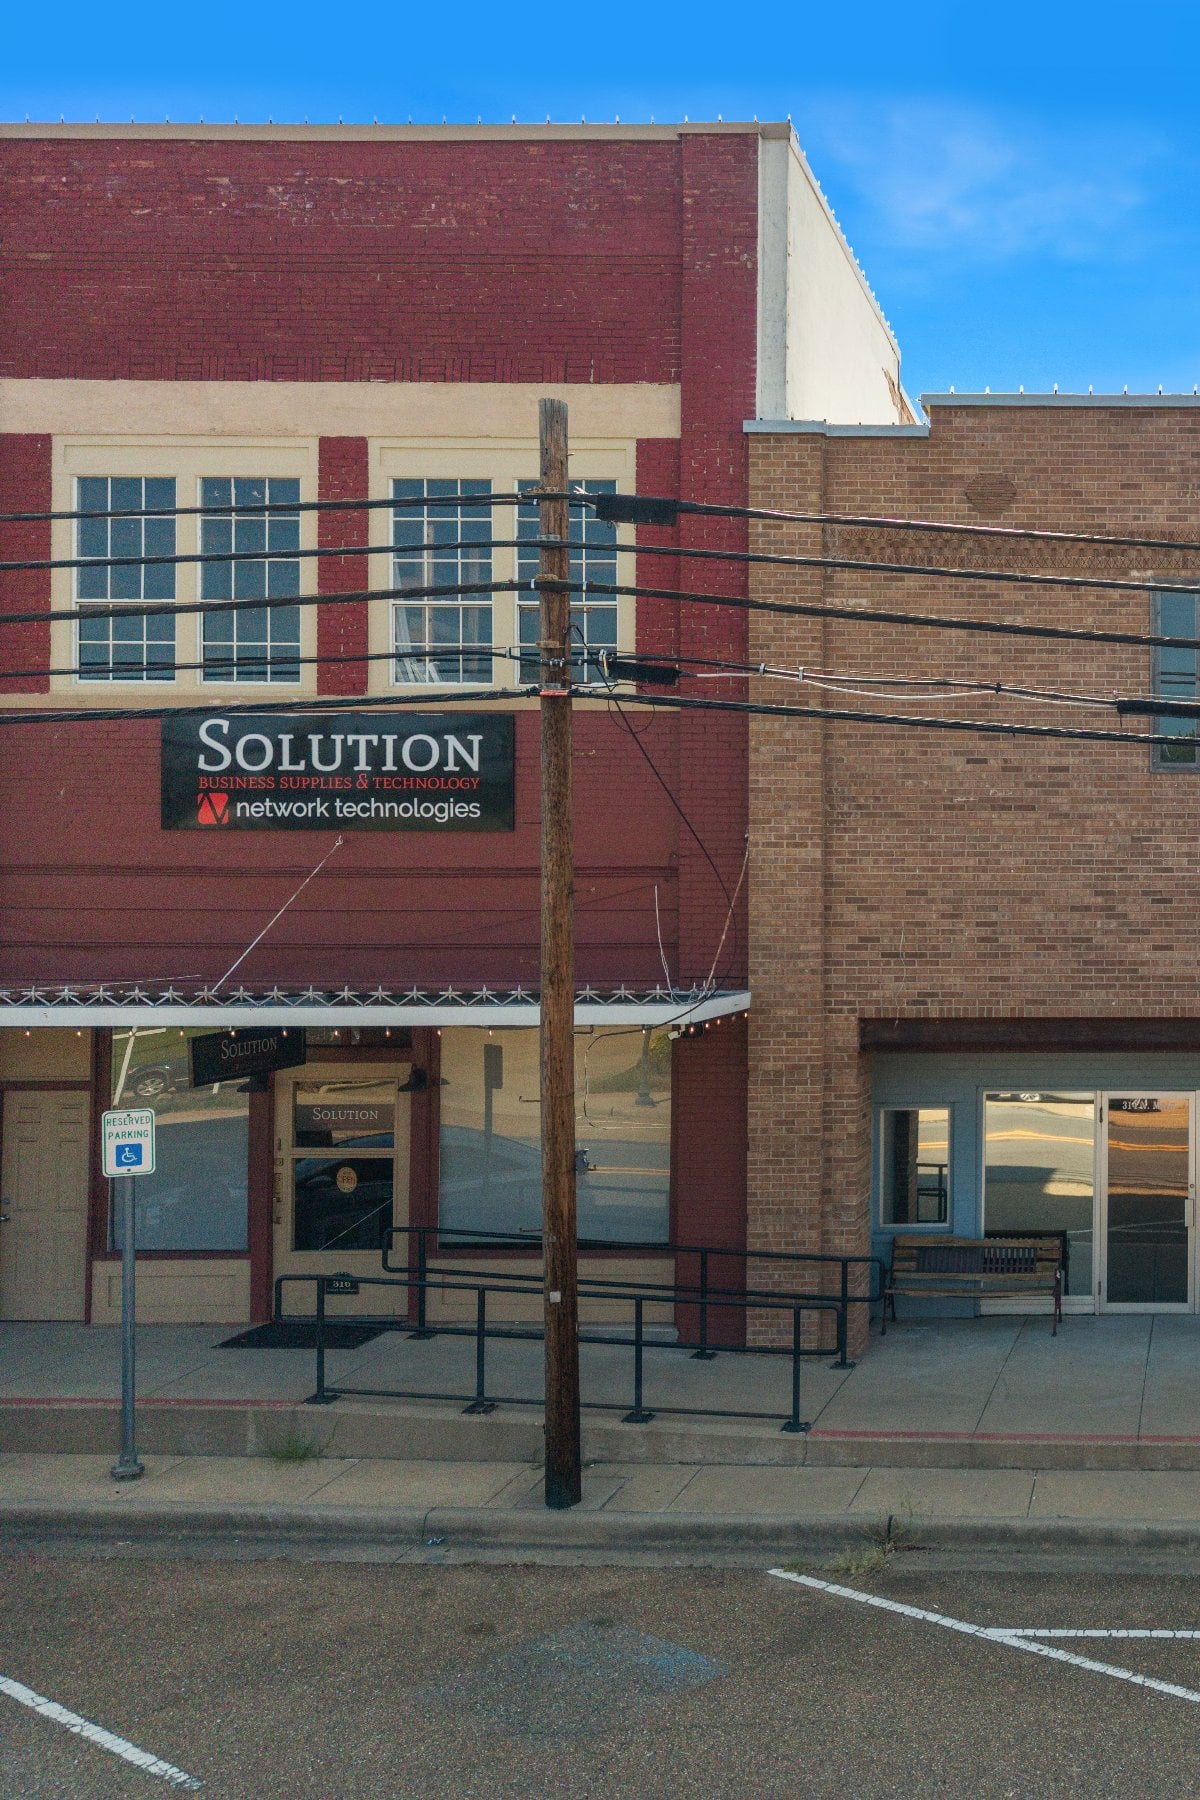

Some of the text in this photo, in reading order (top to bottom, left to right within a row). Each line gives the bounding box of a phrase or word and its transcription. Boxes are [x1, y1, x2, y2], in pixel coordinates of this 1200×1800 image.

[198, 718, 483, 772] SOLUTION
[198, 773, 480, 791] BUSINESS SUPPLIES & TECHNOLOGY
[236, 797, 481, 822] network technologies
[220, 1037, 278, 1060] SOLUTION
[106, 1116, 151, 1127] RESERVED
[312, 1107, 379, 1120] SOLUTION
[108, 1130, 149, 1140] PARKING
